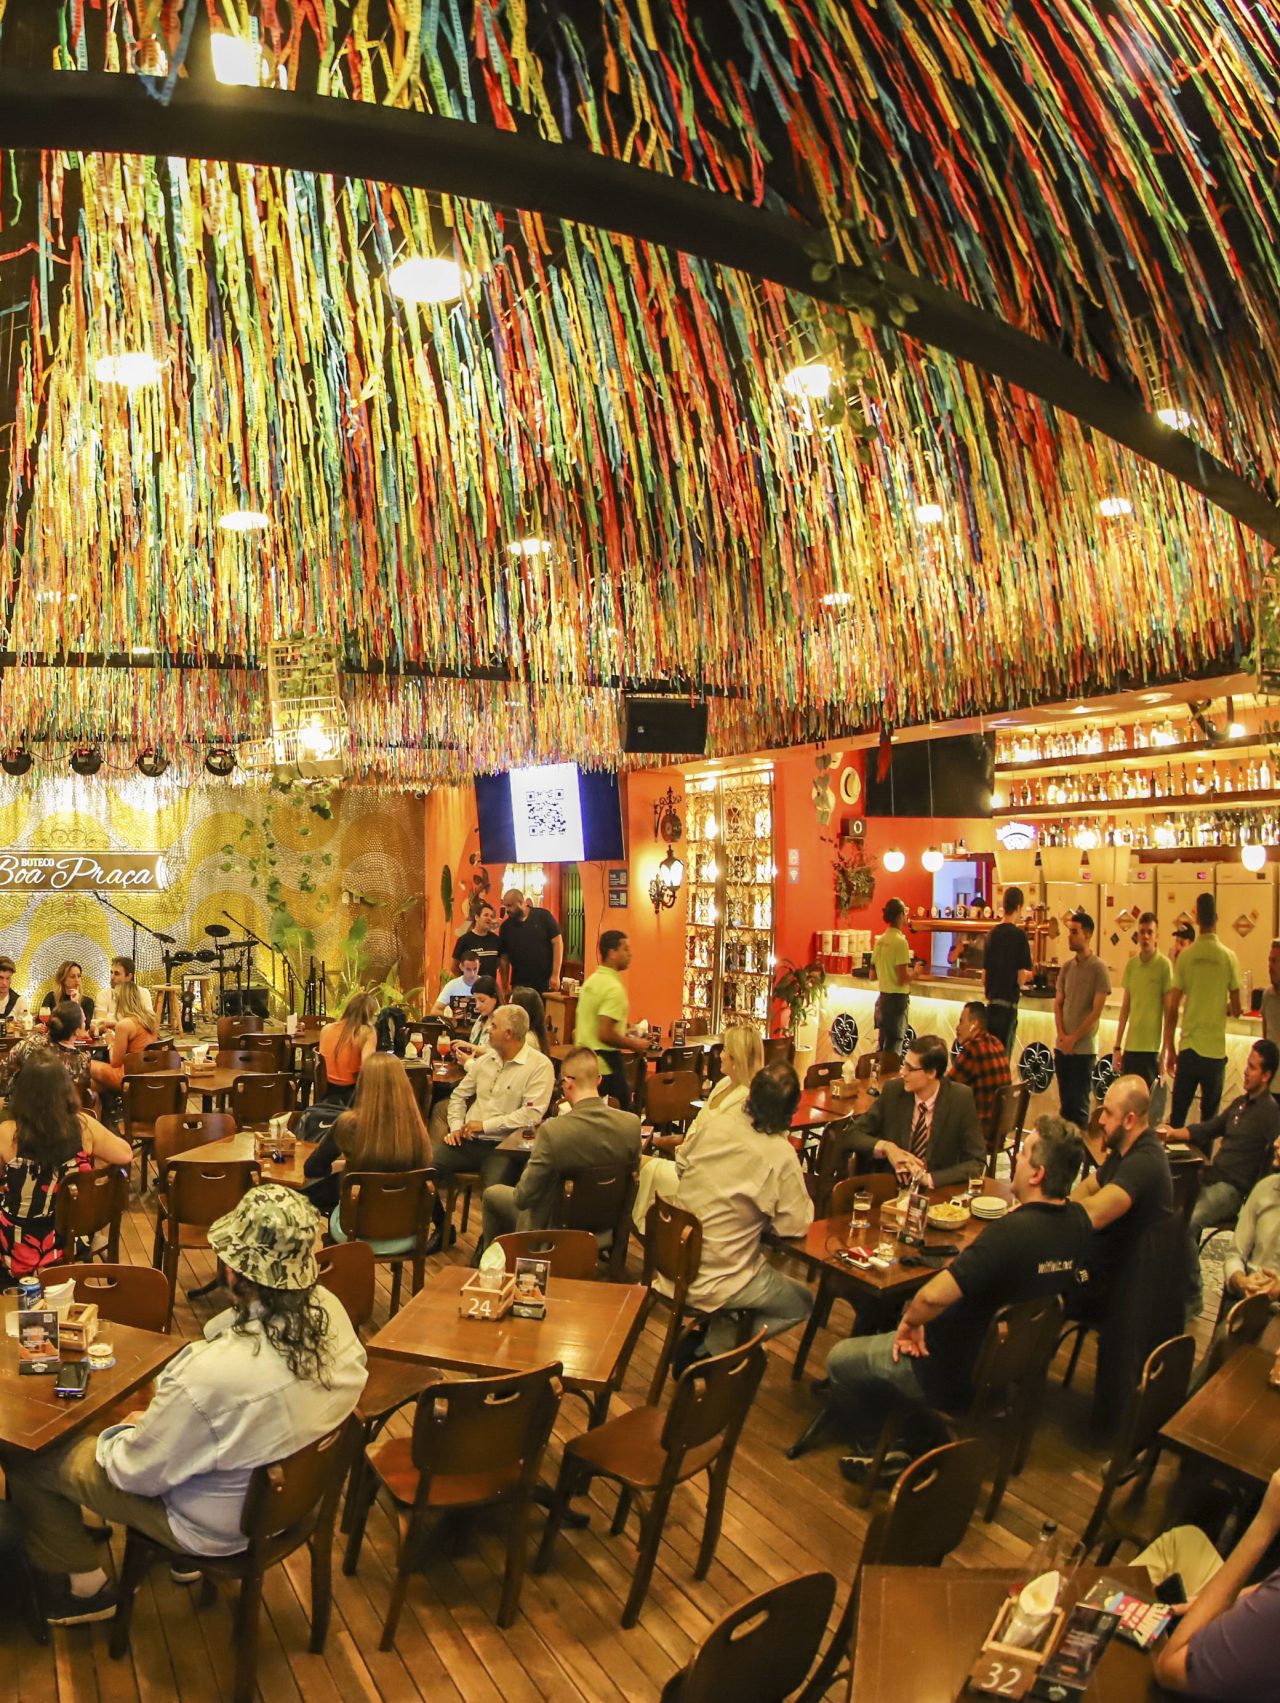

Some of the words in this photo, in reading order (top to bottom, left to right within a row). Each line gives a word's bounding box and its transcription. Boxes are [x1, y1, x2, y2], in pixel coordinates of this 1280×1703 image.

[20, 857, 56, 868] BOTECO
[50, 856, 154, 889] Praça
[468, 1297, 492, 1317] 24
[980, 1662, 1022, 1694] 32
